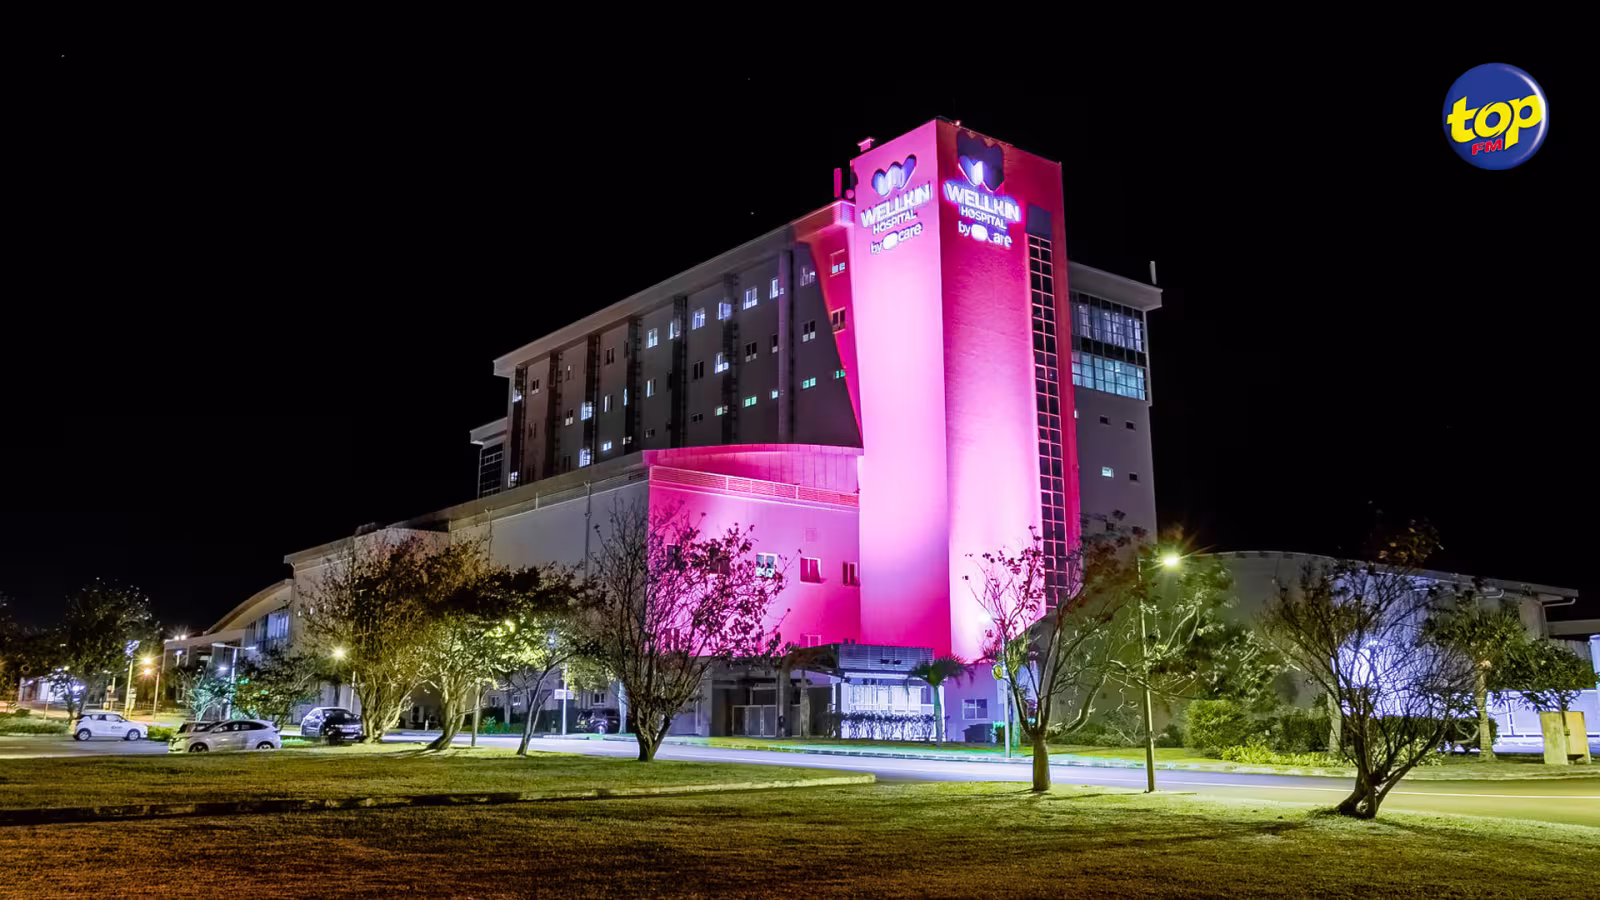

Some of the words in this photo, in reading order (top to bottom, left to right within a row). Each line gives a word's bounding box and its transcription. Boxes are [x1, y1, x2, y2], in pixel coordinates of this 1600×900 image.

[861, 184, 930, 227] WELLKIN
[946, 183, 1020, 222] WELLKIN
[873, 211, 917, 235] HOSPITAL
[958, 221, 971, 237] by
[961, 206, 1007, 230] HOSPITAL
[871, 240, 883, 255] by
